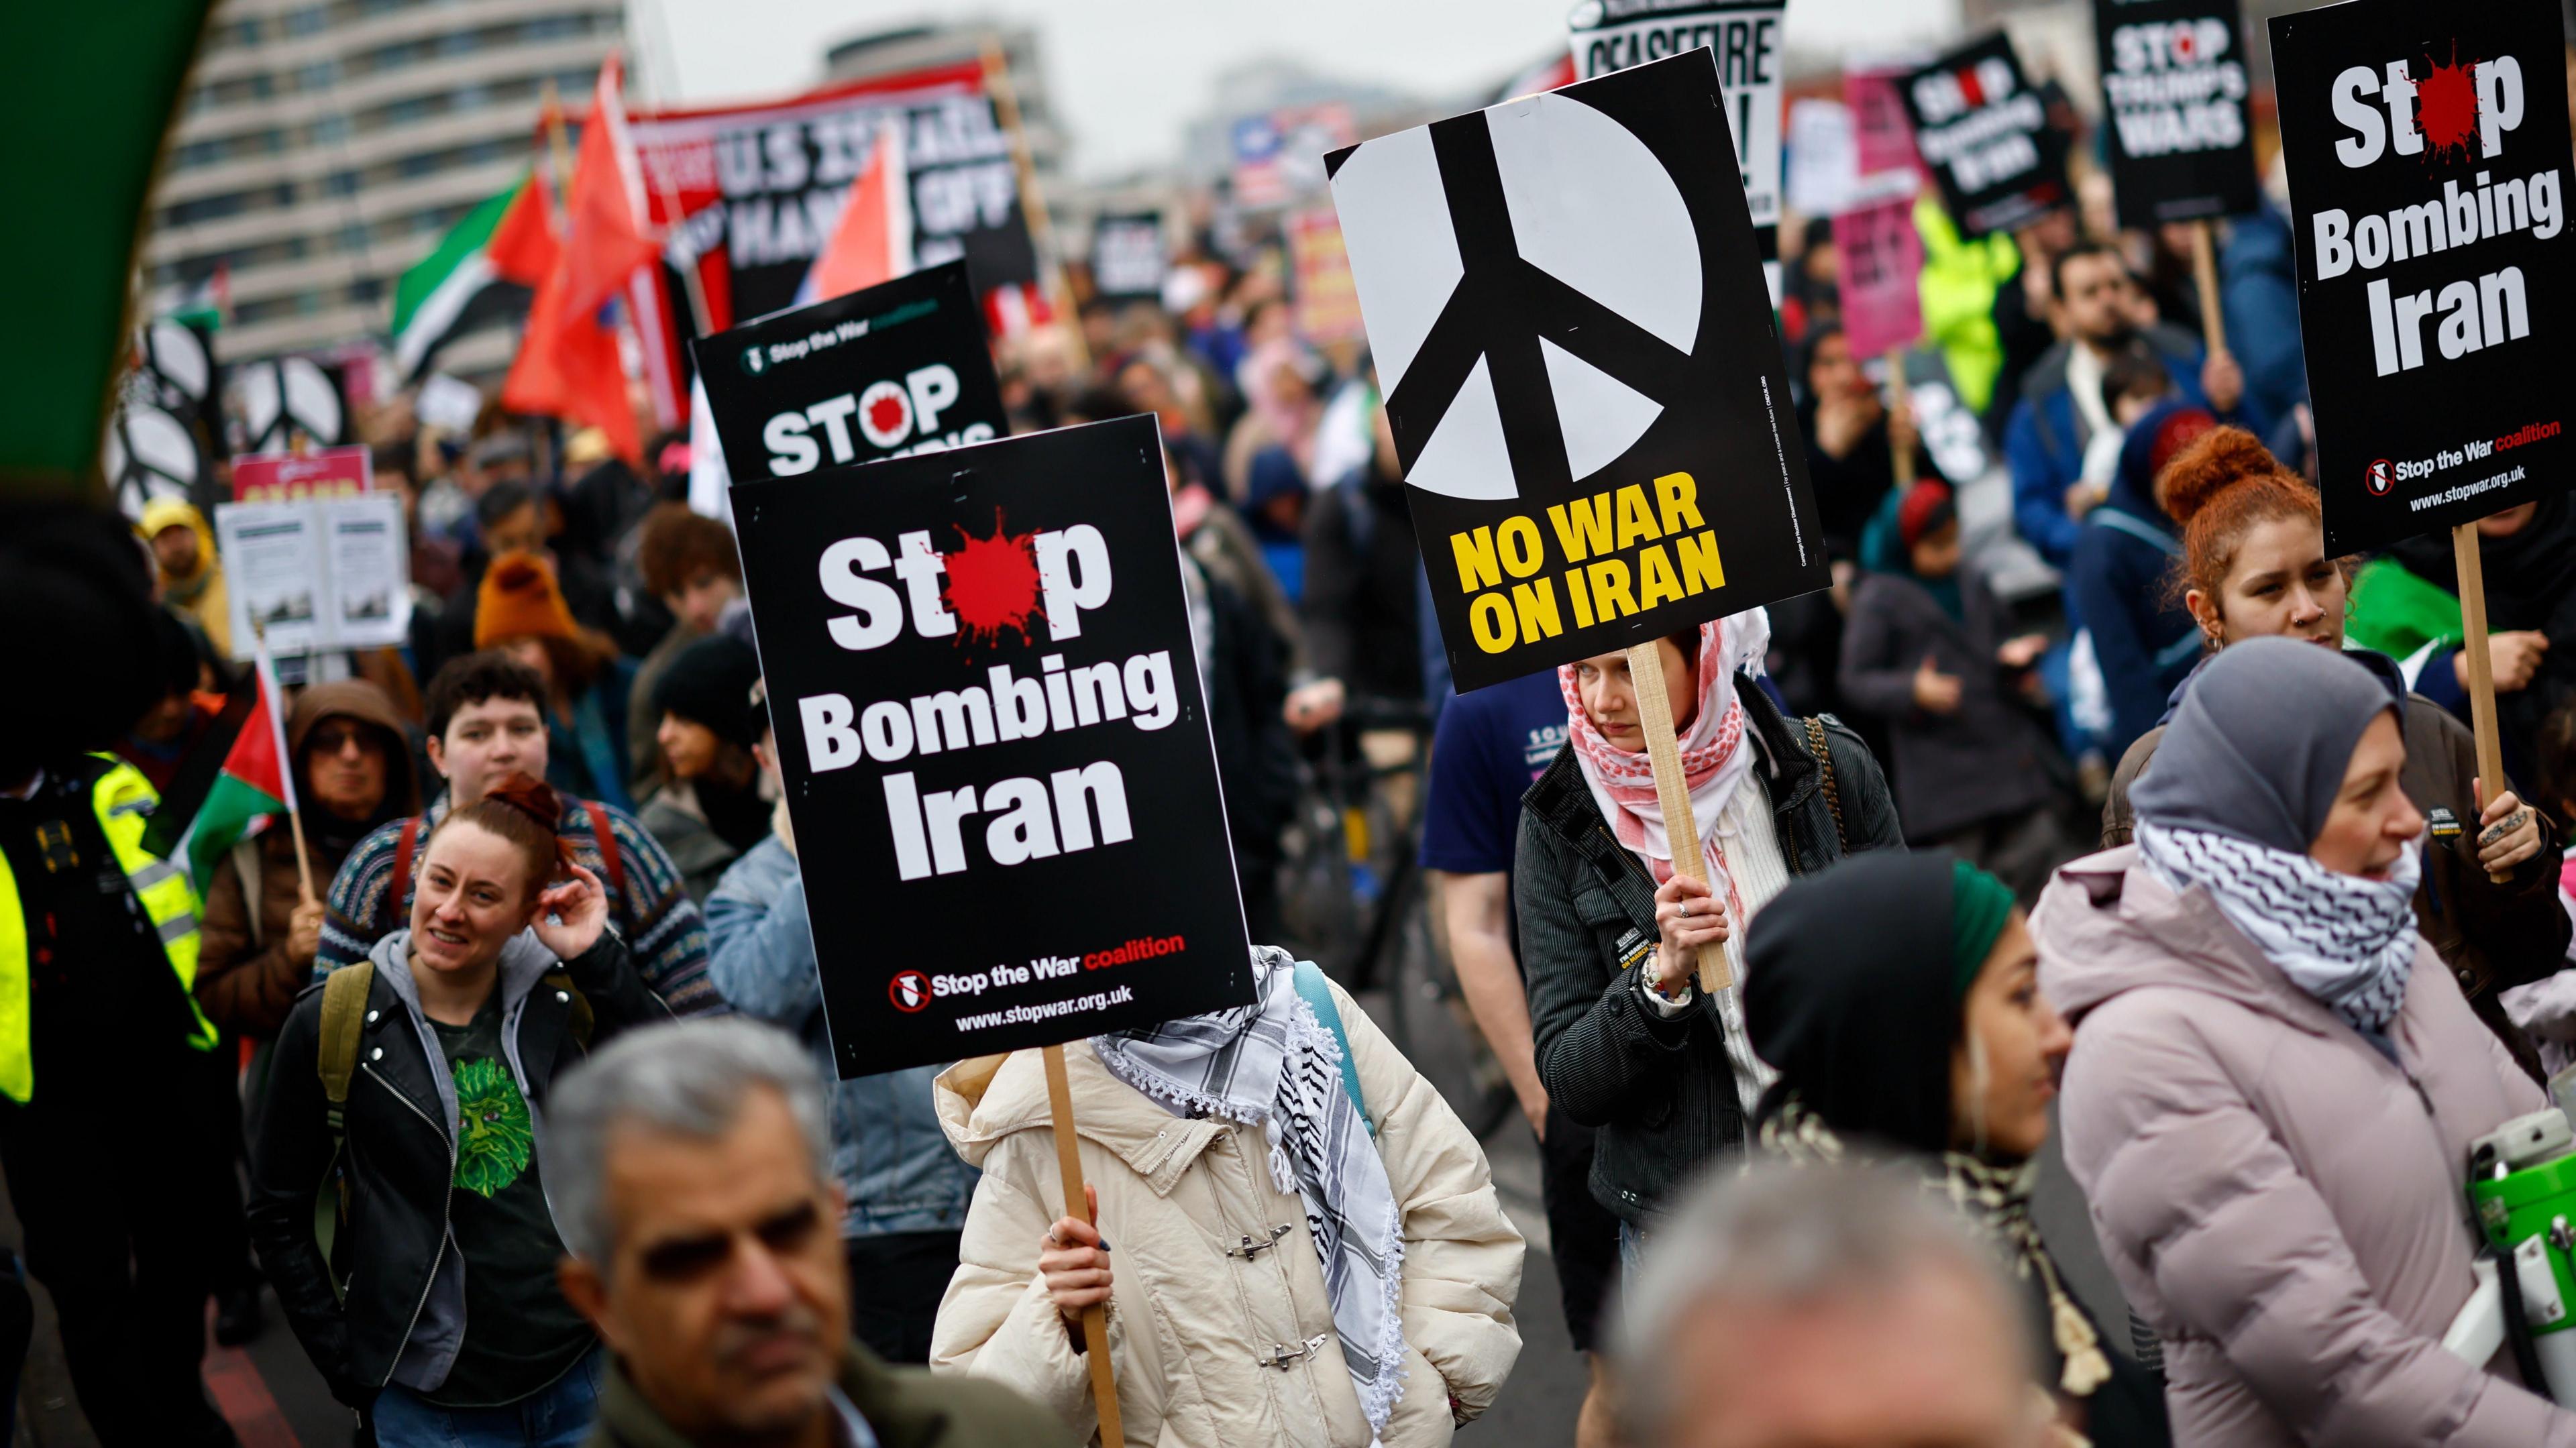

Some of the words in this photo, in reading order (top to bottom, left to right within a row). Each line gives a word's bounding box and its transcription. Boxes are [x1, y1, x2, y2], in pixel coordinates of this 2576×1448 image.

[2112, 17, 2229, 72] STOP
[2116, 101, 2243, 158] WARS
[2331, 55, 2524, 168] Stp
[2313, 169, 2564, 281] Bombing
[769, 341, 808, 364] Stop
[809, 330, 837, 351] the
[837, 319, 870, 343] War
[2367, 266, 2530, 377] Iran
[1760, 376, 1771, 406] CNDUK.ORG
[763, 364, 959, 477] STOP
[1772, 423, 1780, 449] nuclear-free
[2395, 459, 2434, 480] Stop
[2436, 450, 2463, 470] the
[2464, 439, 2493, 462] War
[2496, 421, 2561, 451] coalition
[1785, 486, 1796, 518] Disarmament
[2410, 465, 2526, 512] www.stopwar.org.uk
[1450, 515, 1544, 594] NO
[1546, 471, 1705, 563] WAR
[1798, 543, 1806, 566] Campaign
[818, 524, 1112, 651] Stp
[1469, 576, 1563, 654] ON
[1565, 529, 1725, 629] IRAN
[798, 651, 1179, 773] Bombing
[882, 761, 1133, 881] Iran
[932, 974, 988, 997] Stop
[991, 964, 1030, 987] the
[1031, 956, 1079, 980] War
[1083, 935, 1185, 970] coalition
[1619, 954, 1629, 963] I'M
[1621, 960, 1631, 969] ON
[1629, 946, 1649, 963] MARCH
[955, 985, 1133, 1032] www.stopwar.org.uk
